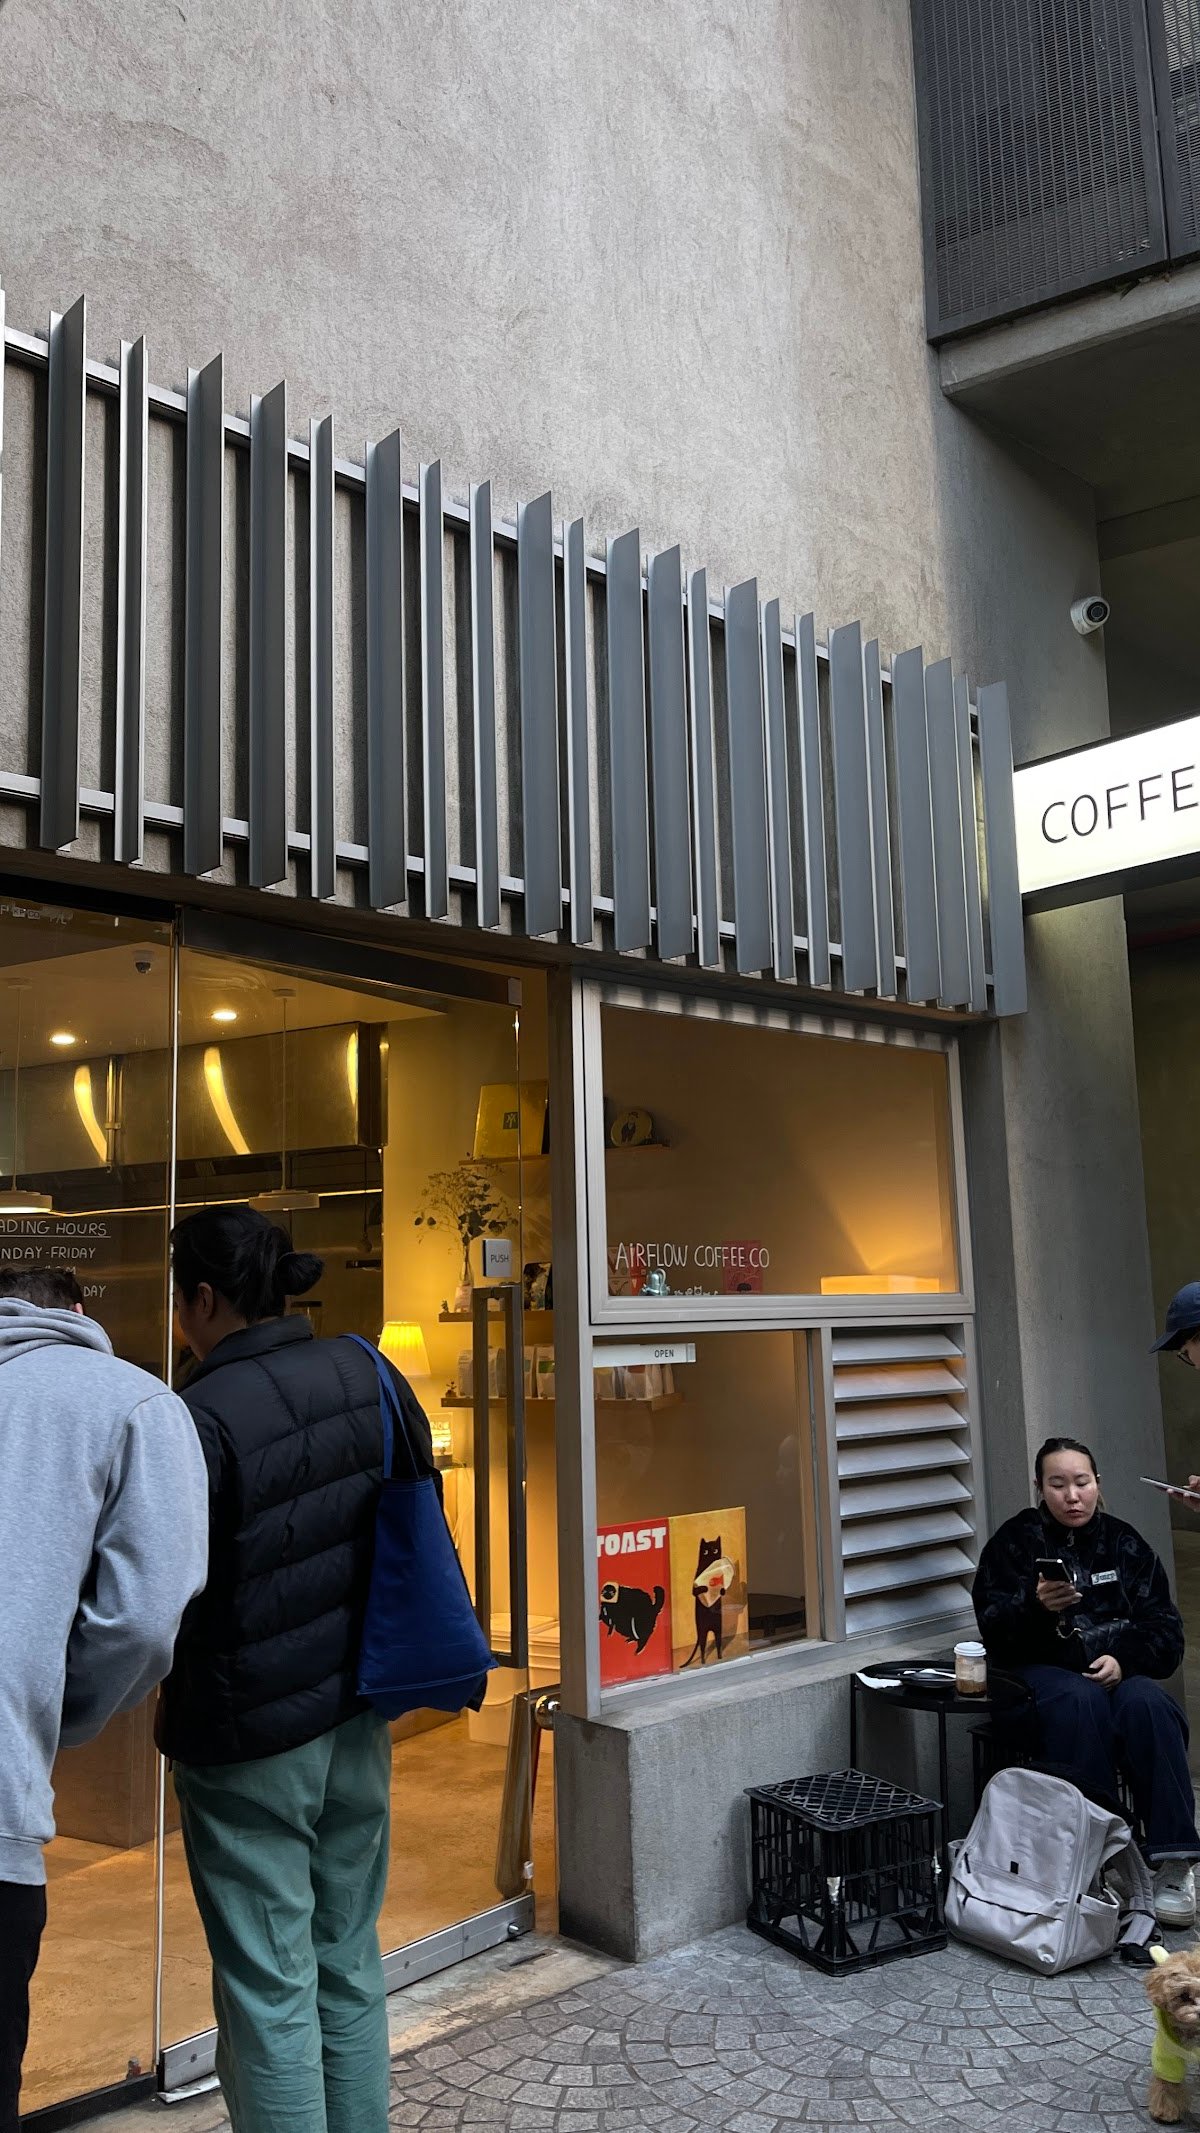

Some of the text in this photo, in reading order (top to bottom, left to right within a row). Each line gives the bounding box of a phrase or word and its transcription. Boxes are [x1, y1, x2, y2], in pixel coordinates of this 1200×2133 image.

[1041, 764, 1199, 844] COFFE
[55, 1222, 107, 1236] HOURS
[490, 1254, 509, 1263] PUSH
[694, 1245, 746, 1268] COFFEE
[749, 1248, 770, 1268] CO
[654, 1349, 674, 1358] OPEN
